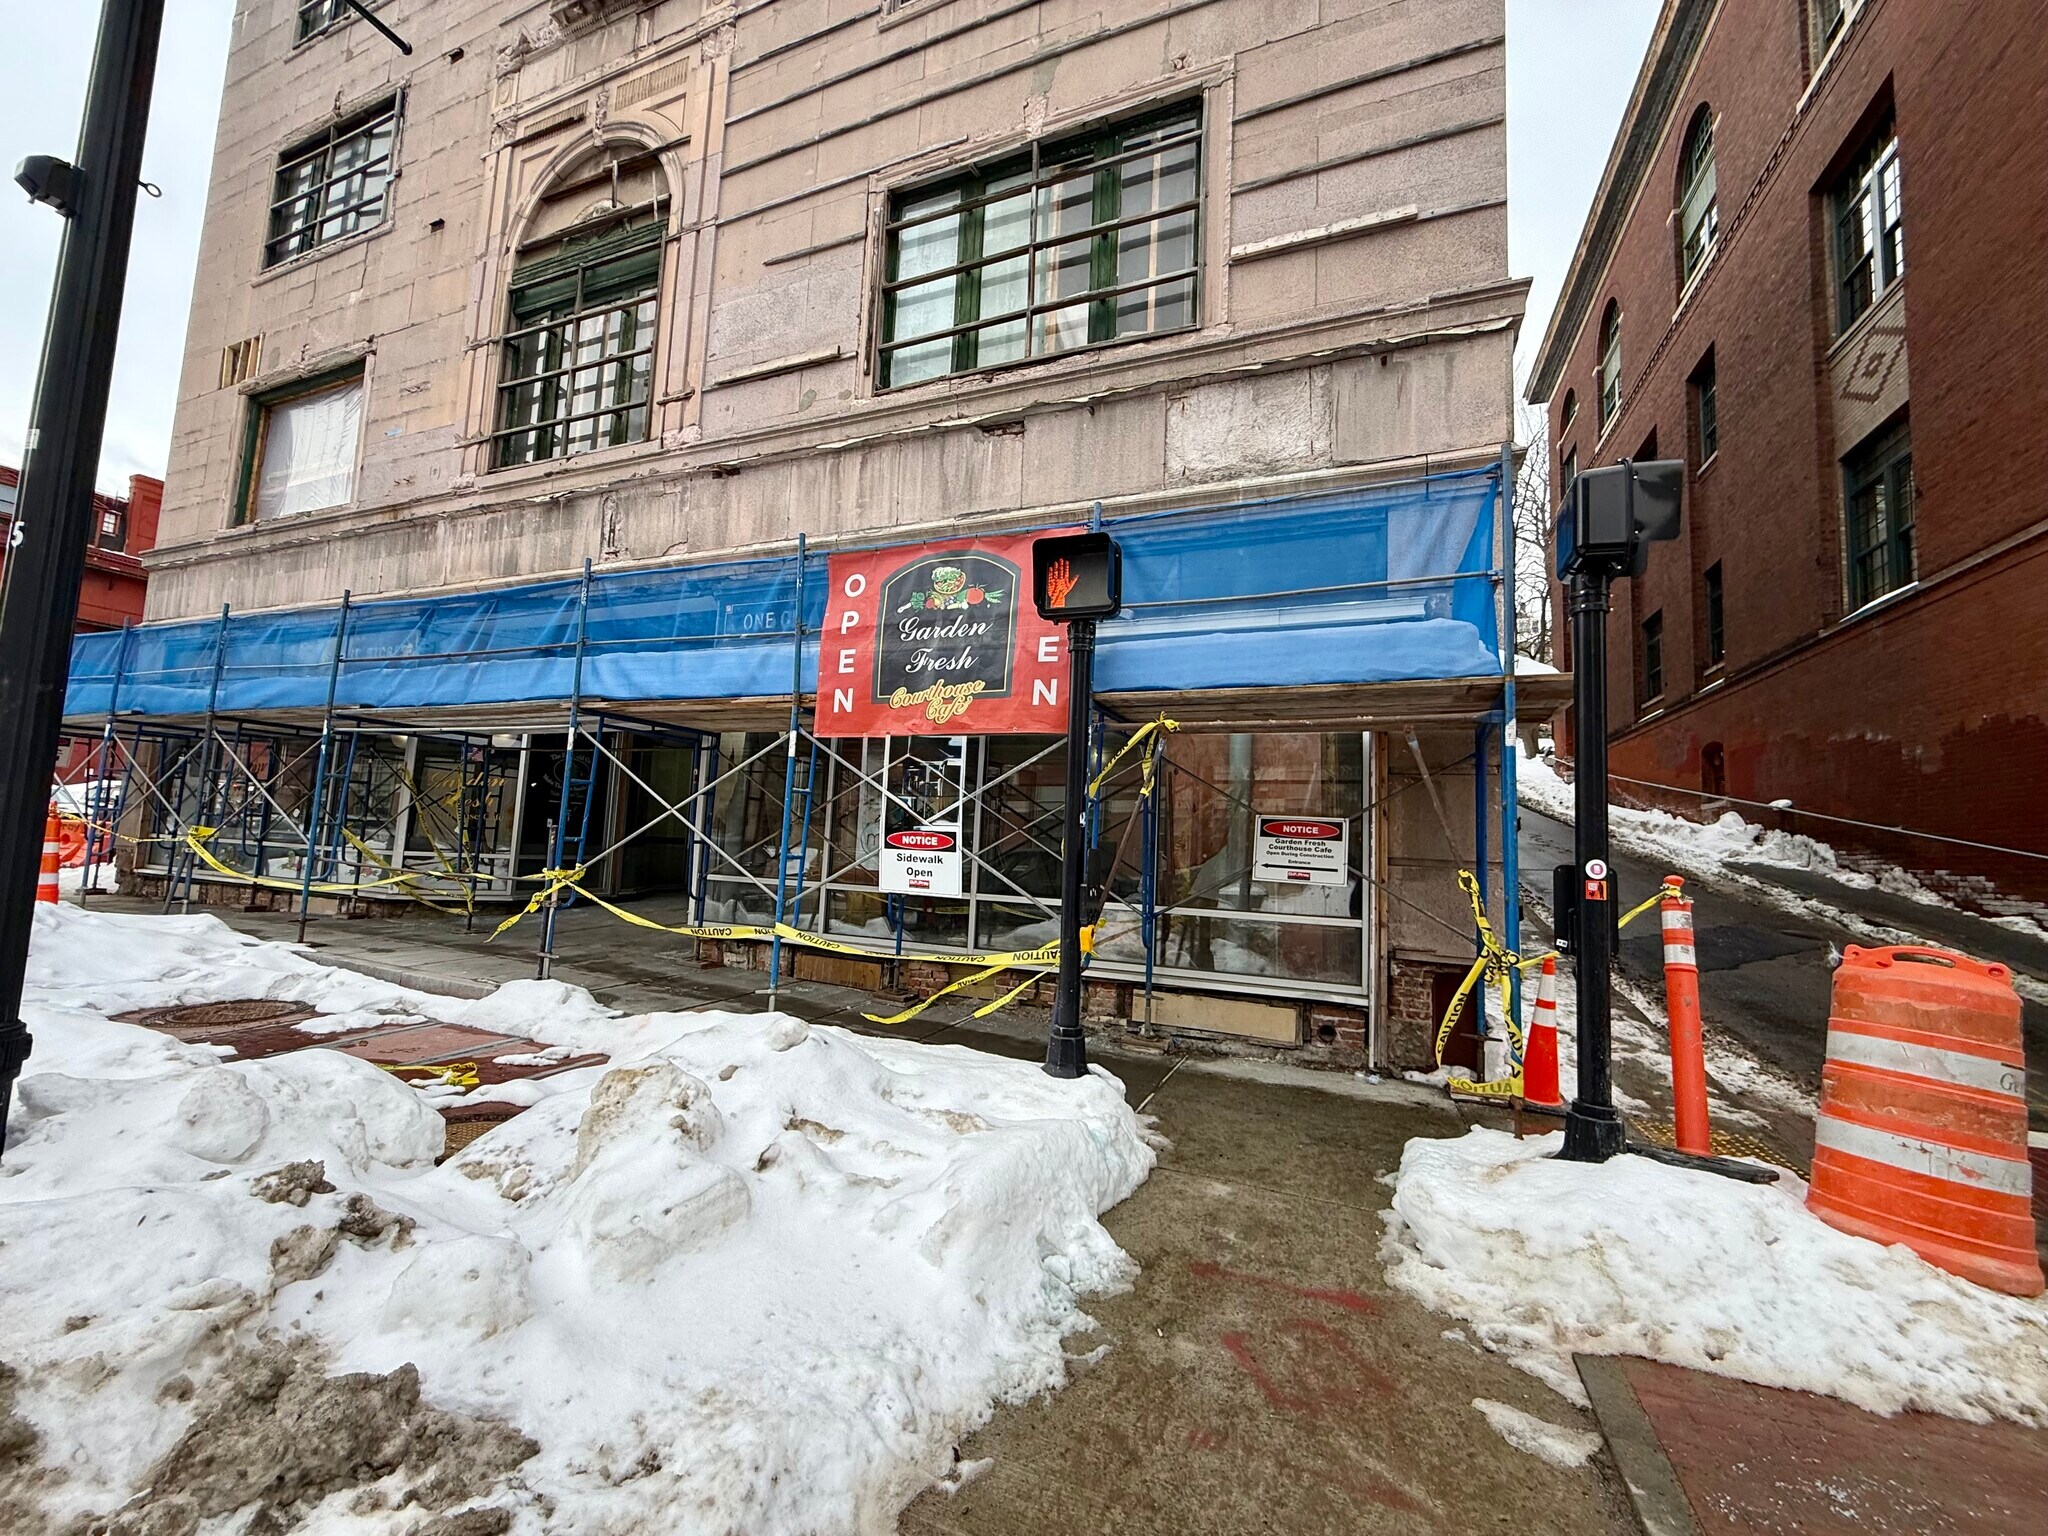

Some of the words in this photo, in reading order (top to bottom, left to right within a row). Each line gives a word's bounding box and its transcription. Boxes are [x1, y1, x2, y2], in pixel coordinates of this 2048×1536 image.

[744, 612, 774, 631] ONE
[898, 614, 993, 642] Garden
[834, 574, 866, 713] OPEN
[906, 645, 978, 673] Fresh
[889, 678, 986, 709] Courthouse
[1282, 825, 1319, 834] NOTICE
[902, 835, 938, 846] NOTICE
[1268, 844, 1312, 852] Courthouse
[896, 853, 944, 865] Sidewalk
[906, 867, 933, 878] Open
[690, 927, 732, 936] CAUTION
[795, 932, 840, 949] CAUTION
[934, 955, 986, 963] CAUTION
[1012, 948, 1061, 961] AUTION
[1437, 992, 1468, 1054] CAUTION
